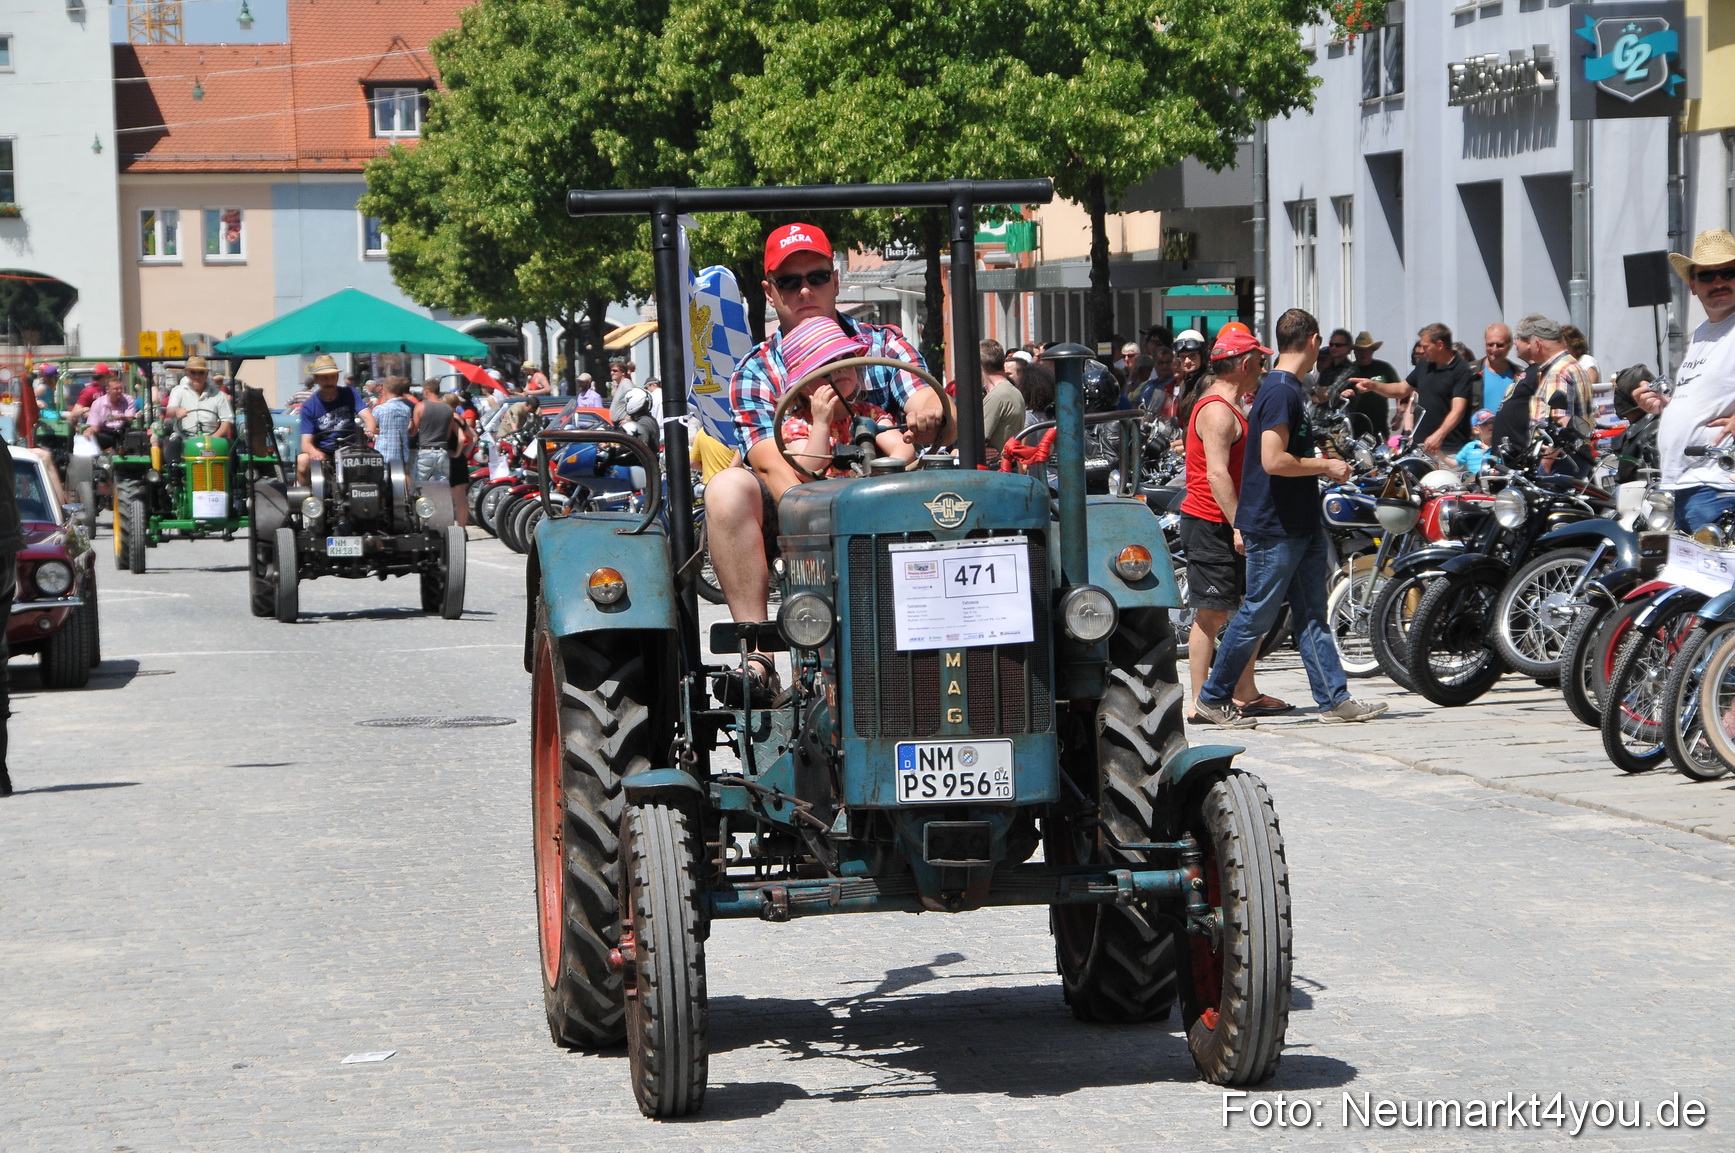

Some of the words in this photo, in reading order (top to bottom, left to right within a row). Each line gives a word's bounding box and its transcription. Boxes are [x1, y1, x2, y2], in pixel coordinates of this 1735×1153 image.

[1612, 33, 1652, 82] G2
[779, 234, 813, 248] DEKRA
[340, 457, 383, 467] KRAMER
[351, 489, 378, 498] Diesel
[790, 559, 826, 586] HANOMAG
[954, 563, 996, 586] 471
[904, 759, 911, 769] D
[918, 747, 954, 772] NM
[994, 771, 1009, 782] 04
[995, 785, 1010, 797] 10
